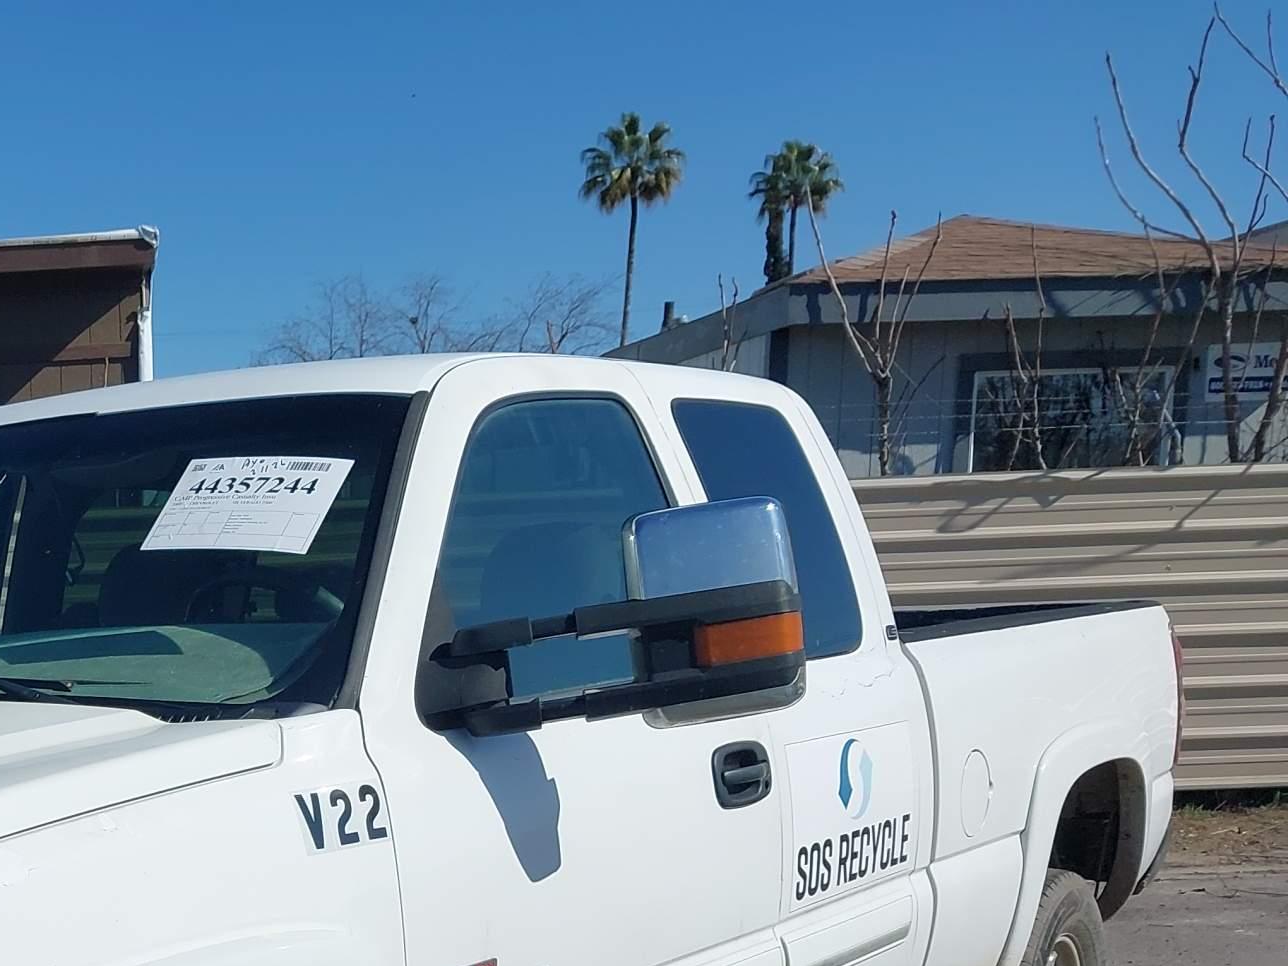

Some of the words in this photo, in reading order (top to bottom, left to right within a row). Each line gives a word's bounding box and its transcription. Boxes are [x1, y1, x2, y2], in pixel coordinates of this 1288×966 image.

[189, 477, 319, 494] 44357244
[294, 784, 388, 849] V22
[796, 838, 833, 901] SOS
[837, 814, 910, 886] RECYCLE
